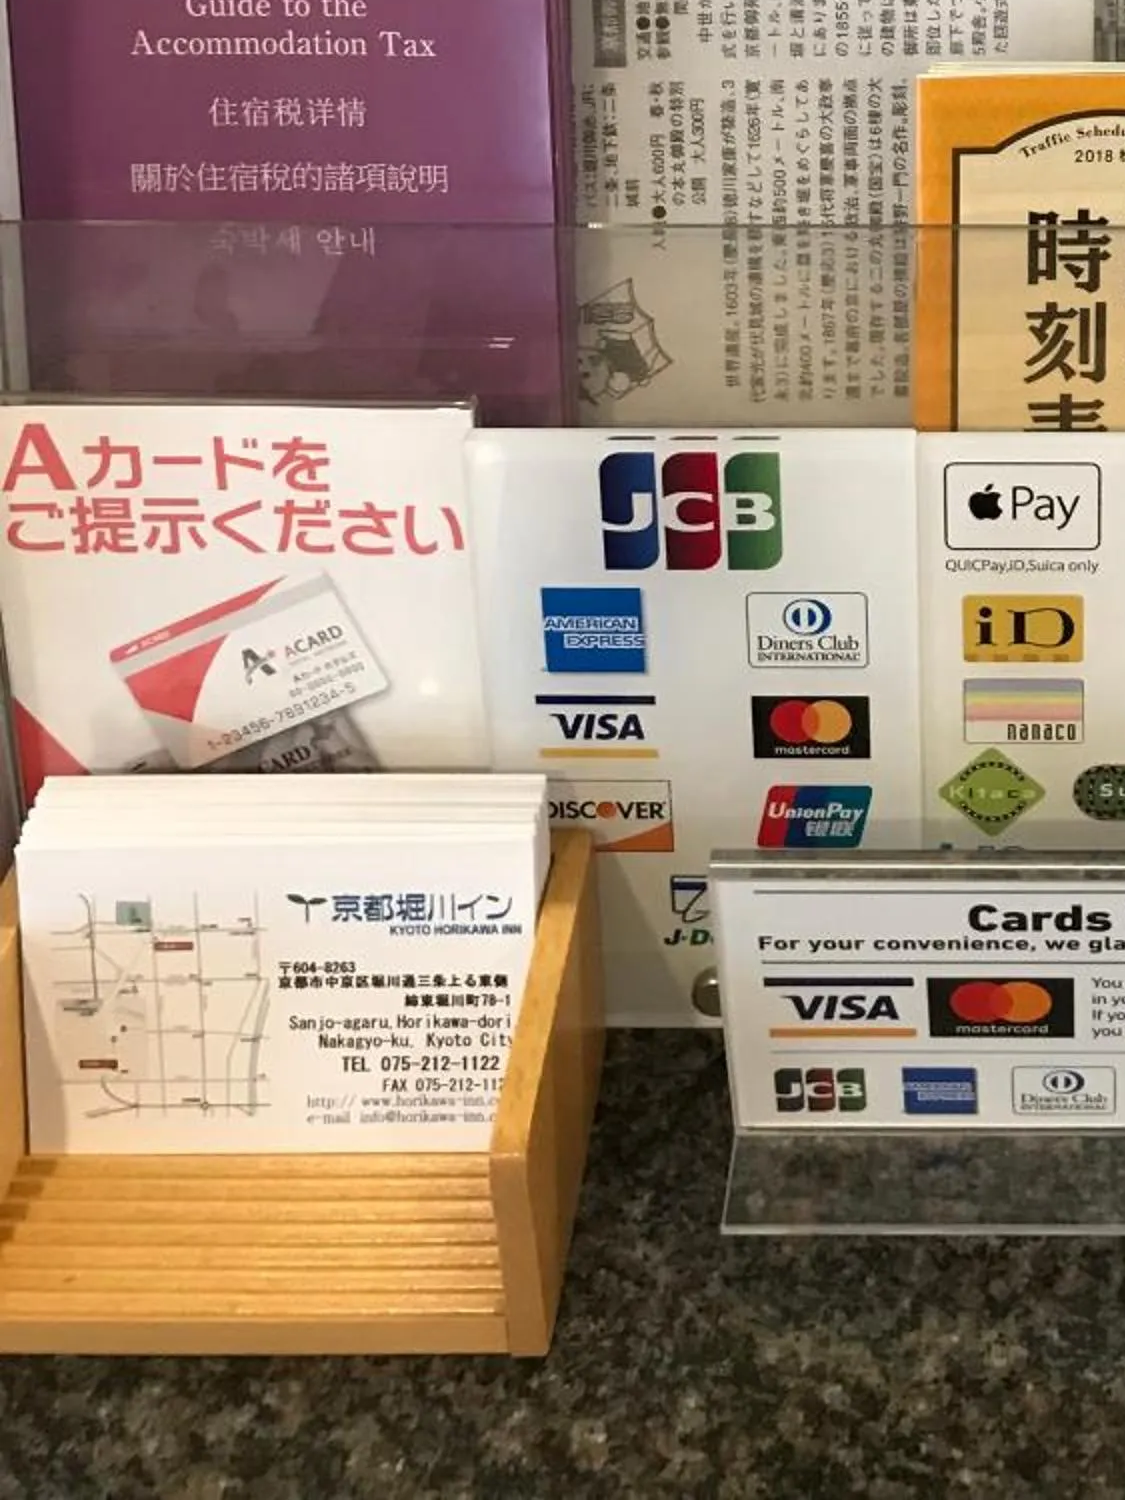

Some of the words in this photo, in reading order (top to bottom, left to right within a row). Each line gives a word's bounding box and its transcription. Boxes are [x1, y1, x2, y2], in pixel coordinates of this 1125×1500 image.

[131, 29, 367, 57] Accommodation
[379, 31, 437, 58] Tax
[208, 96, 367, 128] 住宿税详情
[1073, 148, 1115, 164] 2018
[2, 422, 332, 492] Aカードを
[1009, 485, 1081, 531] Pay
[6, 495, 466, 556] ご提示ください
[1067, 559, 1099, 574] only
[543, 616, 638, 631] AMERICAN
[975, 605, 1076, 648] iD
[564, 634, 646, 648] EXPRESS
[757, 635, 815, 653] Diners
[817, 635, 860, 653] Club
[549, 712, 646, 741] VISA
[1007, 723, 1077, 741] nanaco
[774, 744, 850, 757] mastercard
[767, 801, 865, 825] UnionPay
[331, 893, 513, 921] 京都堀川イン
[969, 904, 1112, 933] Cards
[390, 924, 431, 936] KYOTO
[433, 924, 500, 936] HORIKAWA
[502, 925, 523, 936] INN
[759, 936, 801, 950] For
[808, 938, 864, 953] your
[873, 936, 1036, 953] convenience,
[1045, 938, 1080, 950] we
[1092, 977, 1121, 990] You
[783, 995, 900, 1021] VISA
[955, 1022, 1050, 1035] mastercard
[426, 1033, 472, 1049] Kyoto
[1092, 1027, 1123, 1040] you
[342, 1056, 371, 1073] TEL
[381, 1055, 501, 1072] 075-212-1122
[382, 1079, 407, 1092] FAX
